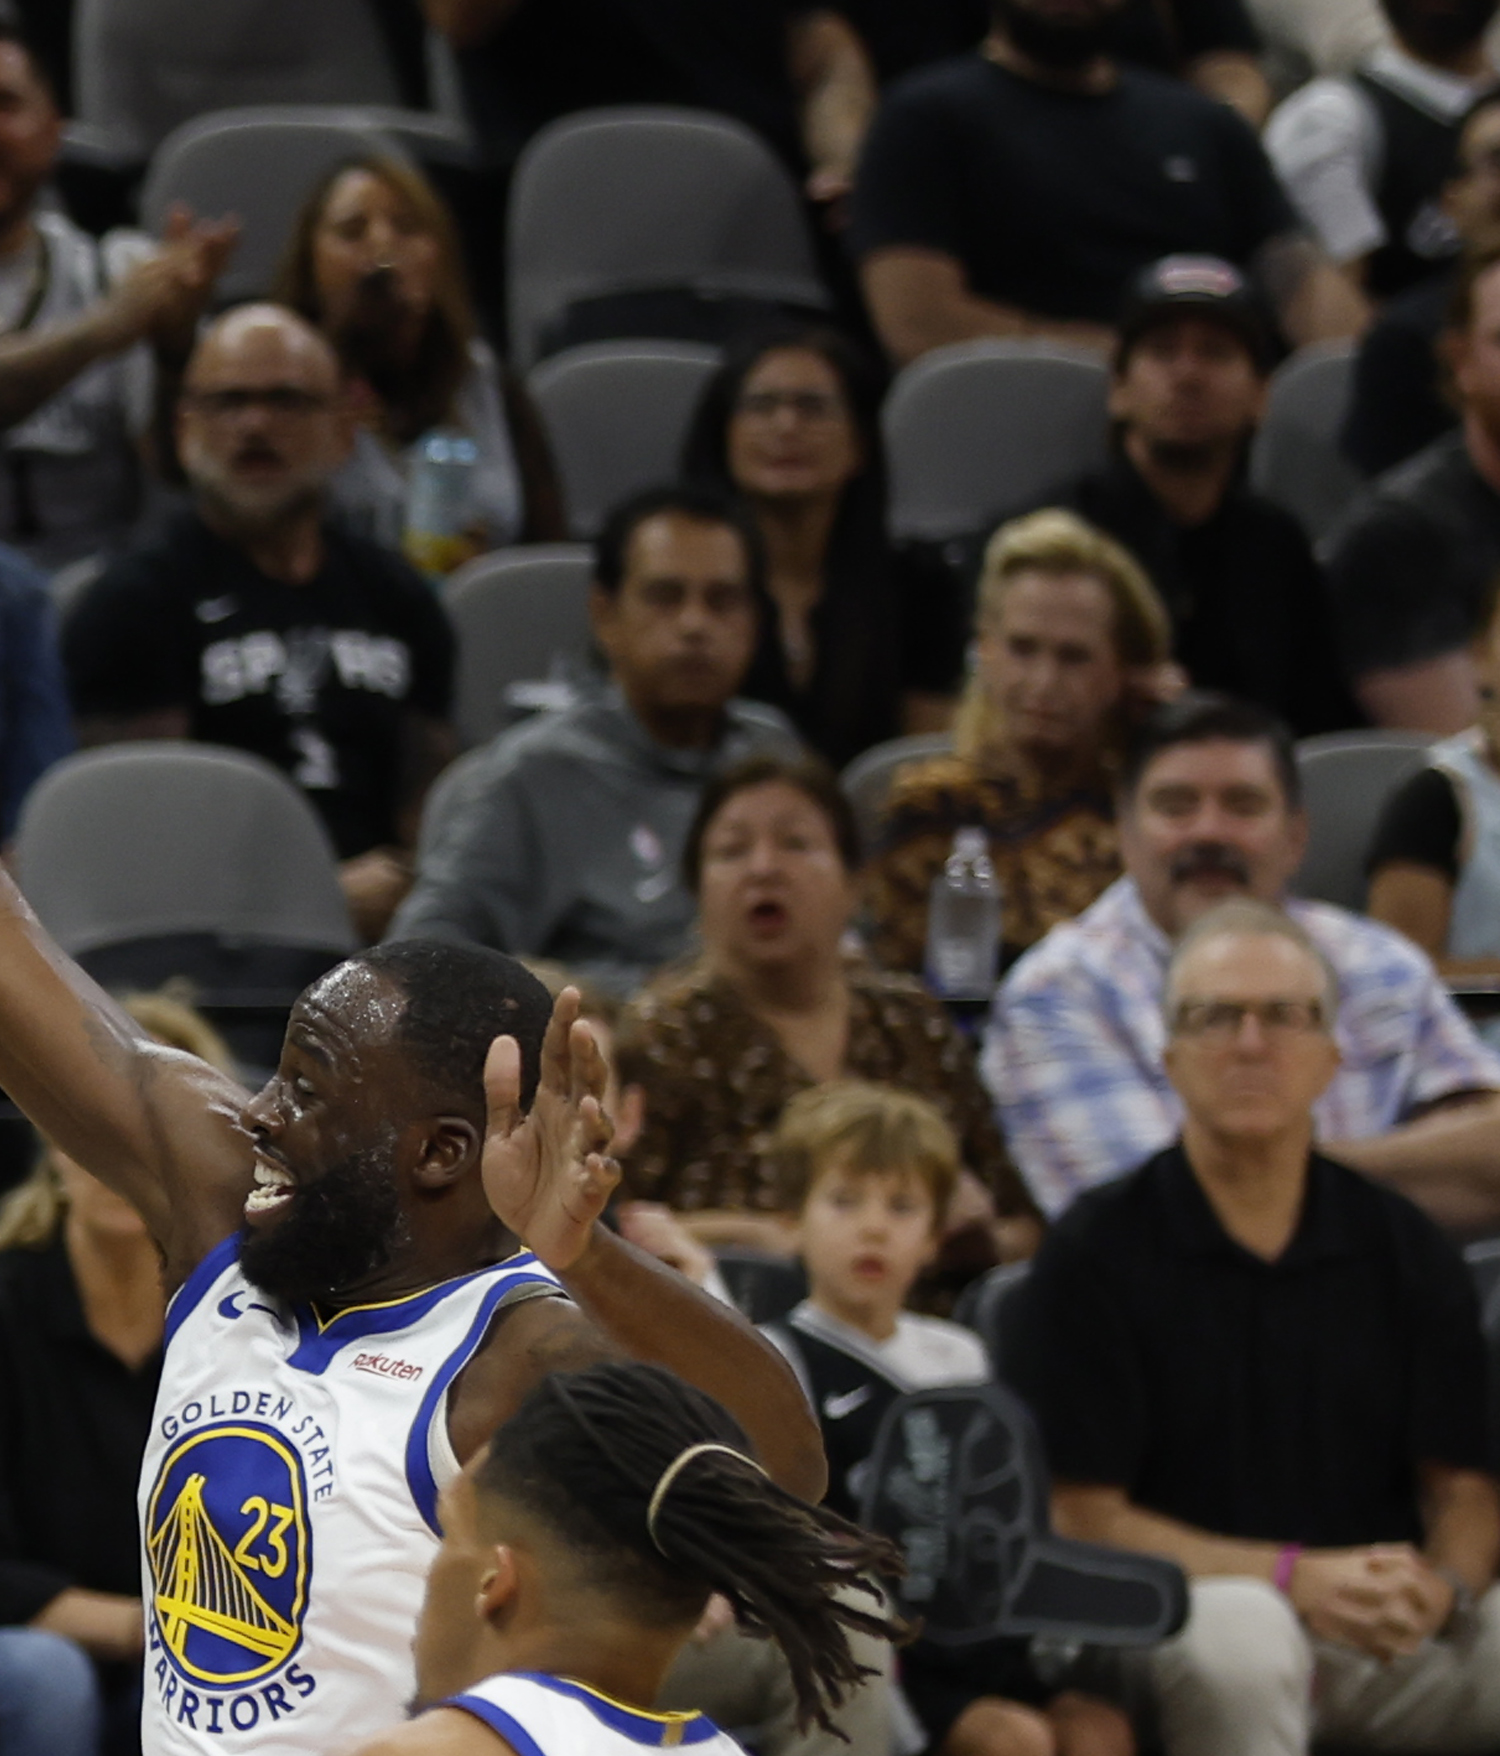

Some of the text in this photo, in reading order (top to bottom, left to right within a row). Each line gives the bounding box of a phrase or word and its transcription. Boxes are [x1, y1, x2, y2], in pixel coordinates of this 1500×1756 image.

[160, 1390, 336, 1503] GOLDEN STATE
[234, 1495, 295, 1579] 23
[148, 1597, 317, 1734] WARRIORS
